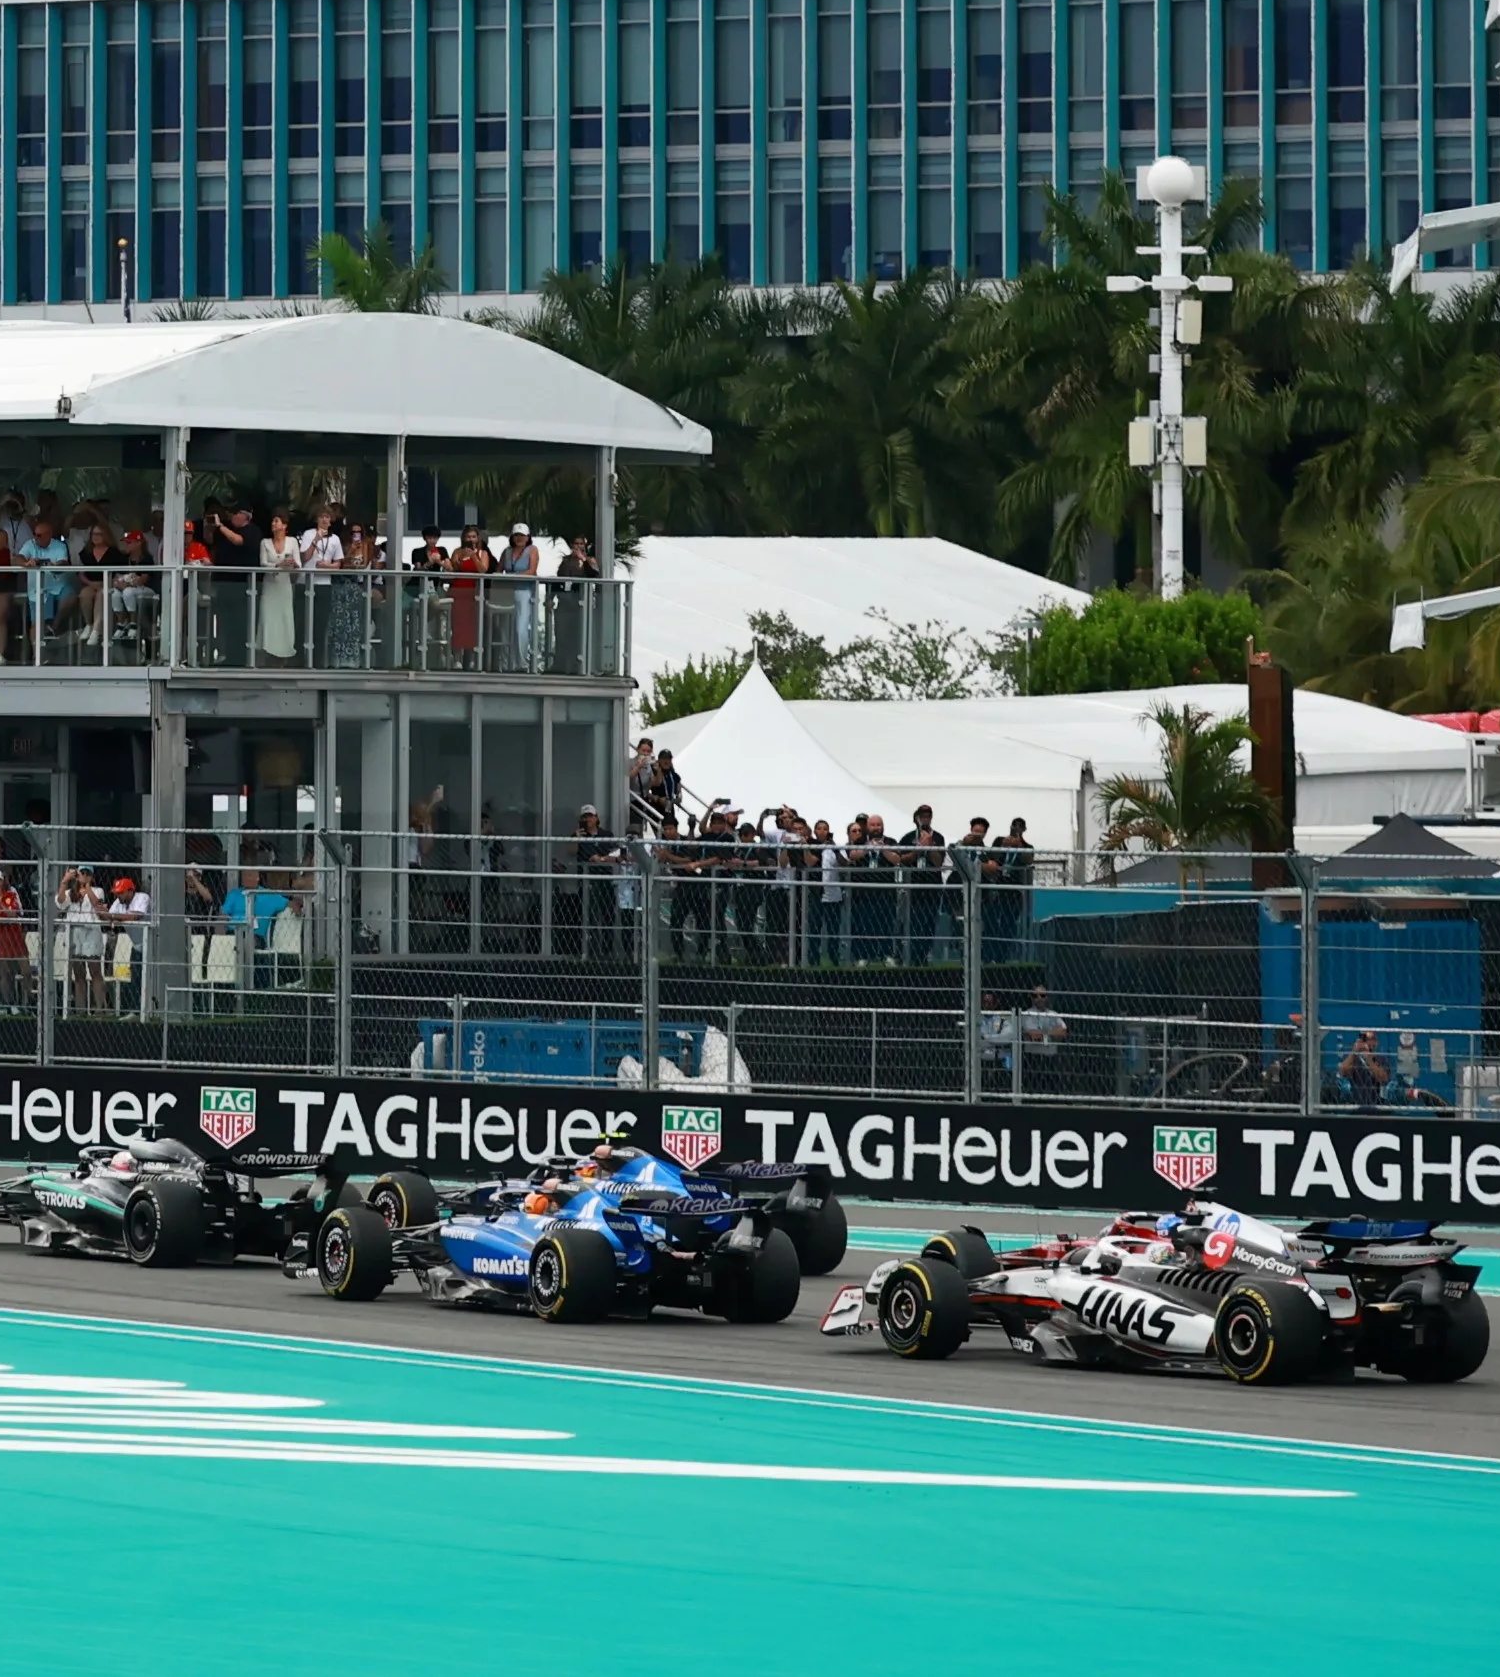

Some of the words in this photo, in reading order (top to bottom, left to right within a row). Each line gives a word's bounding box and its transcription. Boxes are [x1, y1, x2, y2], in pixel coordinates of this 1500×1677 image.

[205, 1090, 251, 1111] TAG
[203, 1113, 255, 1145] HEUER
[666, 1108, 719, 1132] TAG
[665, 1134, 721, 1167] HEUER
[1158, 1130, 1213, 1153] TAG
[238, 1152, 328, 1166] CROWDSTRIKE
[1155, 1154, 1217, 1188] HEUER
[34, 1189, 87, 1210] PETRONAS
[1232, 1245, 1297, 1277] MoneyGram
